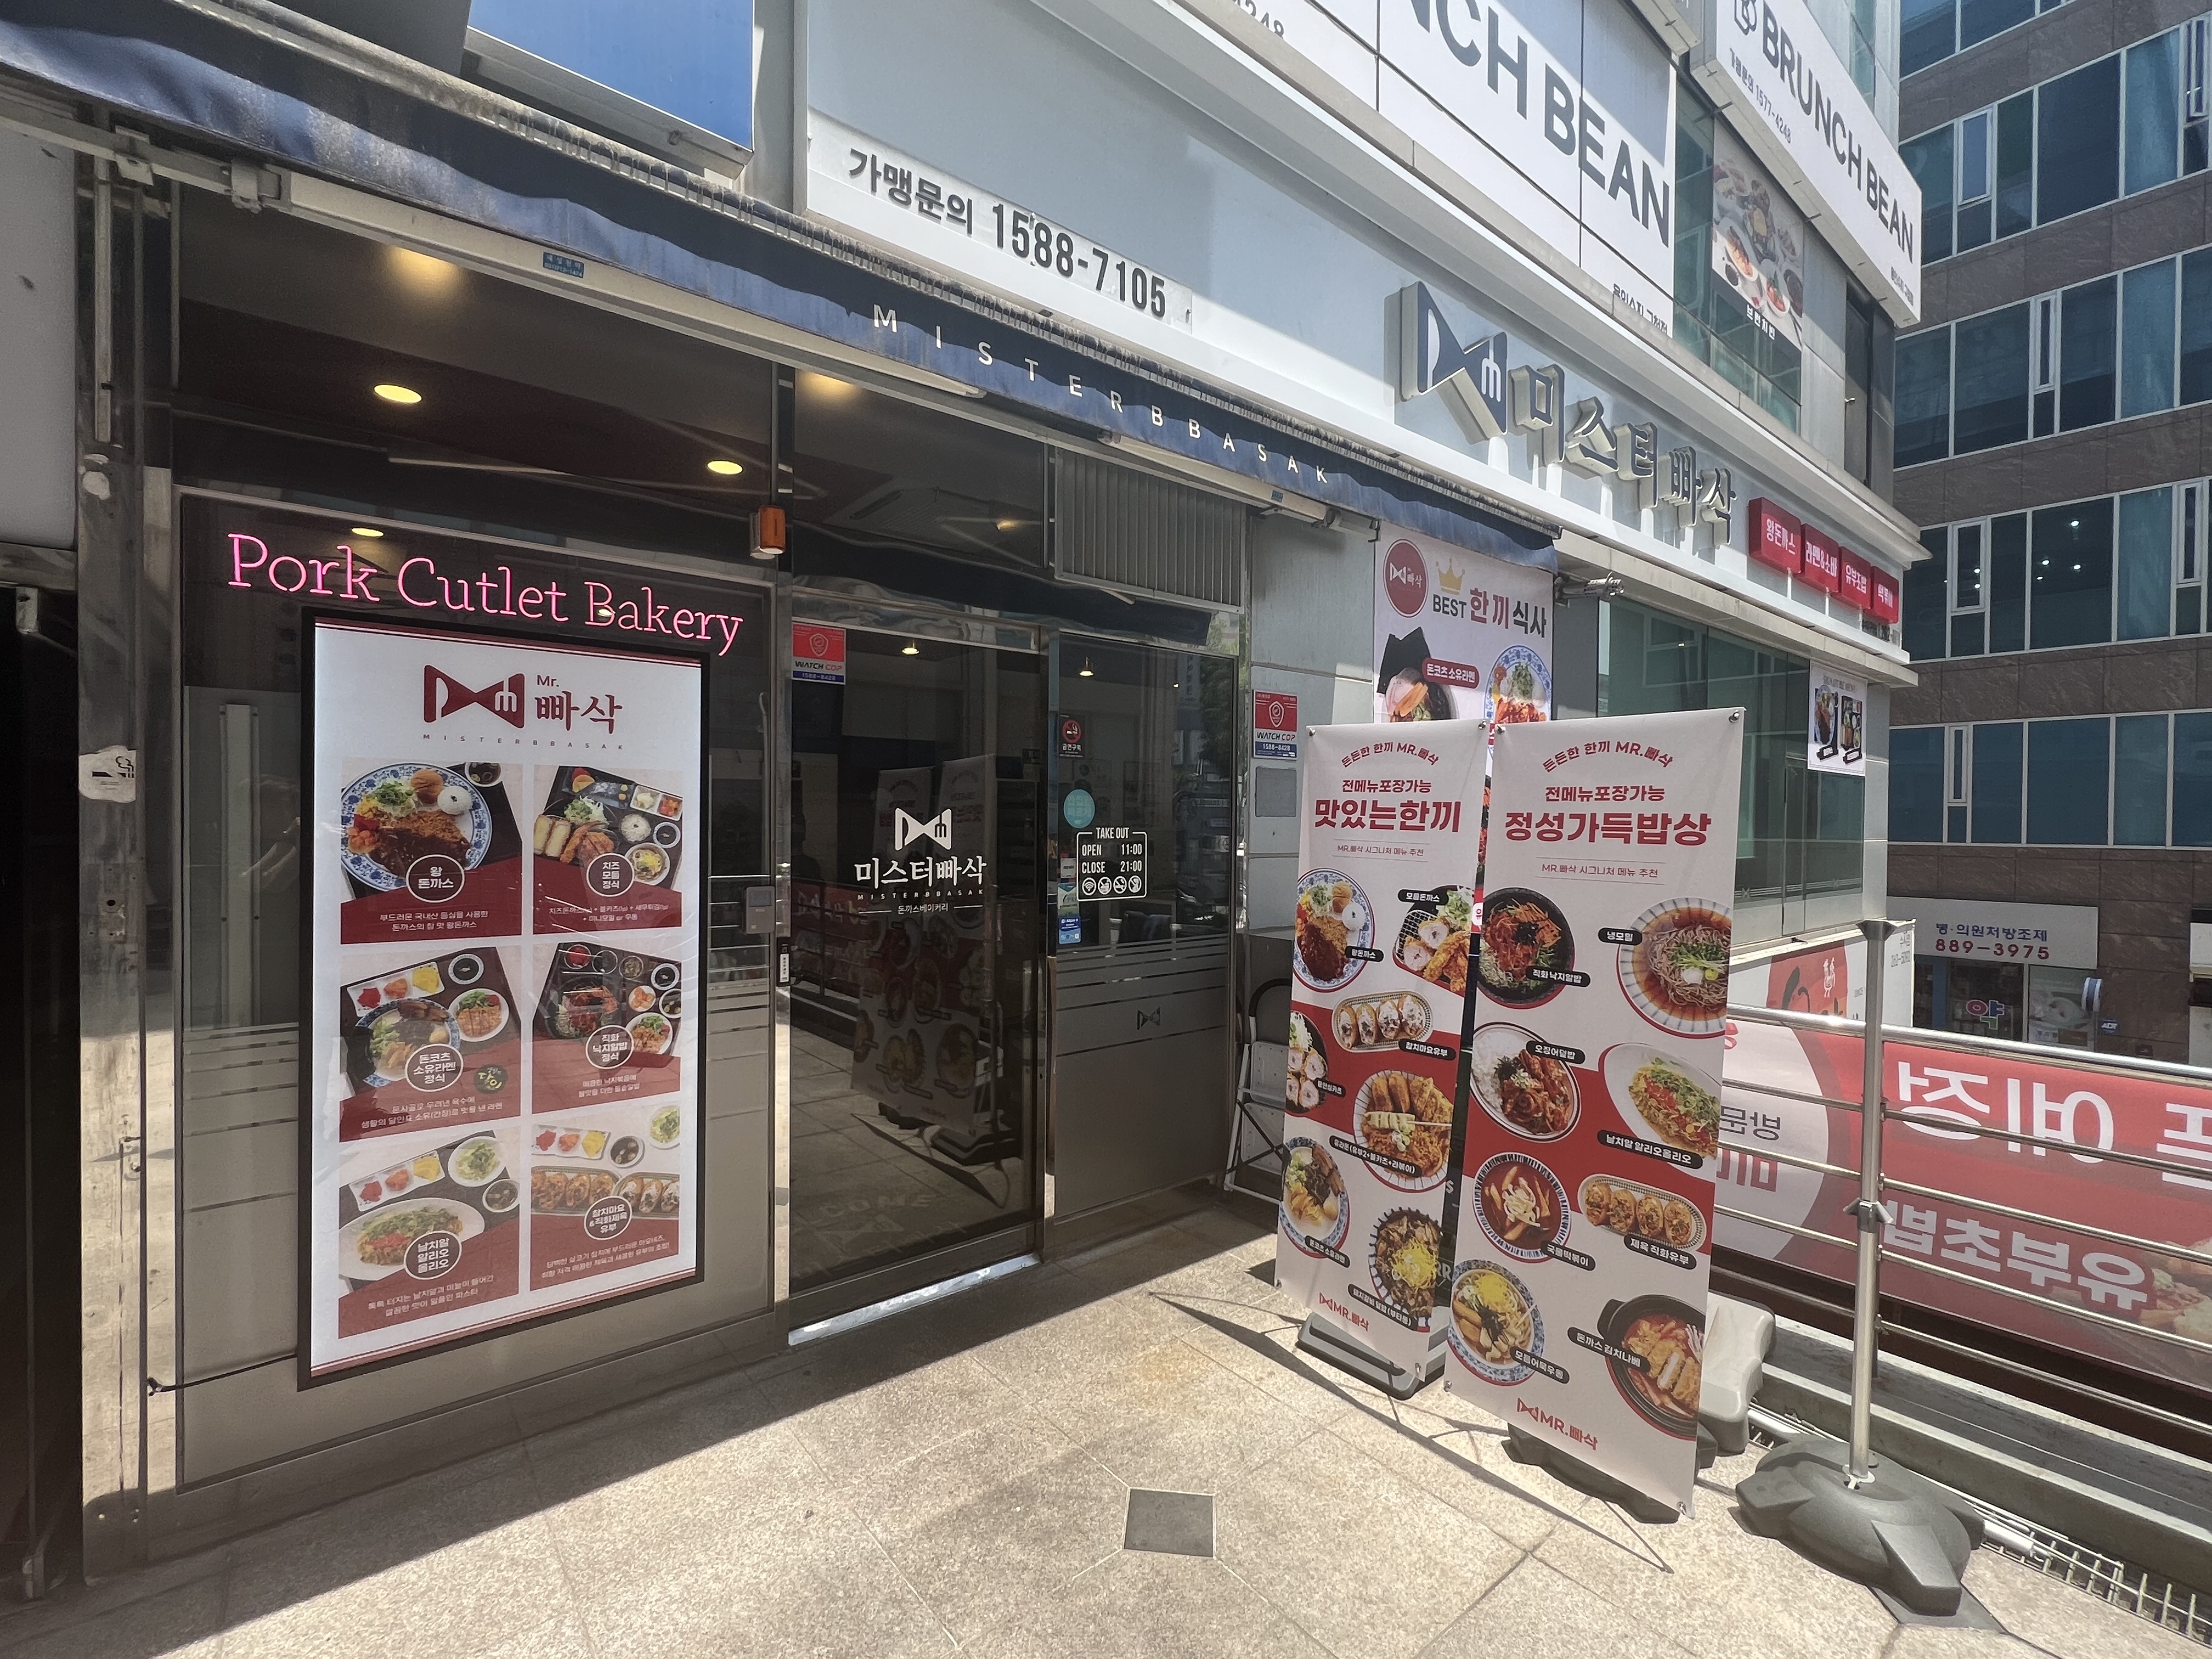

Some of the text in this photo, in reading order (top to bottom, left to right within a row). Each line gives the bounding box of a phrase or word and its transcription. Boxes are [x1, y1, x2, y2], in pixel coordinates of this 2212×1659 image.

[1756, 84, 1791, 144] 1577-4248
[1763, 0, 1913, 264] BRUNCH BEAN
[1545, 61, 1669, 249] BEAN
[848, 148, 1166, 320] 가맹문의 1588-7105
[1746, 303, 1776, 341] 브런치빈
[872, 304, 1329, 486] MISTERBBASAK
[1510, 364, 1737, 546] 미스터빠삭
[1766, 517, 1796, 555] 왕돈까스
[1845, 565, 1867, 594] 유부초밥
[228, 533, 743, 657] Pork Cutlet Bakery
[1432, 587, 1547, 639] BEST 한끼 식사
[794, 661, 824, 670] WATCH
[537, 674, 560, 688] Mr.
[535, 690, 623, 734] 빠삭
[423, 733, 624, 751] MISTERBBASAK
[1257, 732, 1280, 740] WATCH
[1062, 743, 1082, 752] 금연구역
[1341, 746, 1370, 768] 든든한
[1373, 742, 1393, 754] 한끼
[1542, 740, 1674, 774] 든든한 한끼 MR.빠삭
[1342, 779, 1432, 793] 전메뉴포장가능
[1545, 785, 1666, 803] 전메뉴포장가능
[1314, 799, 1462, 833] 맛있는한끼
[1096, 827, 1130, 839] TAKE OUT
[1505, 811, 1712, 847] 정성가득밥상
[1082, 843, 1142, 856] OPEN 11:00
[1364, 845, 1392, 854] 시그니처
[1393, 847, 1408, 856] 메뉴
[1409, 848, 1424, 857] 추천
[430, 866, 443, 877] 왕
[602, 861, 620, 870] 치즈
[854, 855, 988, 889] 미스터빠삭
[1082, 861, 1106, 874] CLOSE
[1120, 860, 1142, 872] 21:00
[1542, 864, 1658, 878] MR.빠삭 시그니처 메뉴 추천
[418, 878, 454, 889] 돈까스
[602, 879, 620, 889] 정식
[857, 889, 984, 900] MISTERBBASAK
[898, 902, 949, 915] 돈까스베이커리
[380, 913, 413, 922] 부드러운
[392, 923, 425, 932] 돈까스의
[1607, 930, 1634, 943] 냉모밀
[1351, 948, 1376, 960] 왕돈까스
[1935, 938, 2050, 959] 889-3975
[1532, 968, 1549, 980] 직화
[601, 1032, 619, 1042] 직화
[592, 1042, 628, 1053] 낙지알밥
[1406, 1041, 1448, 1057] 참치마요유부
[1534, 1043, 1576, 1060] 오징어덮밥
[419, 1052, 451, 1064] 돈코츠
[601, 1052, 620, 1063] 정식
[413, 1061, 456, 1075] 소유라멘
[424, 1073, 446, 1084] 정식
[1606, 1133, 1692, 1165] 날치알 알리오올리오
[592, 1204, 625, 1218] 참치마요
[600, 1223, 617, 1234] 유부
[417, 1237, 450, 1253] 날치알
[417, 1248, 449, 1263] 알리오
[1547, 1243, 1590, 1267] 국물떡볶이
[417, 1259, 449, 1274] 올리오
[386, 1294, 411, 1306] 터지는
[455, 1288, 478, 1299] 파스타
[1576, 1331, 1641, 1368] 돈까스 김치나베
[1540, 1412, 1599, 1451] MR.빠삭
